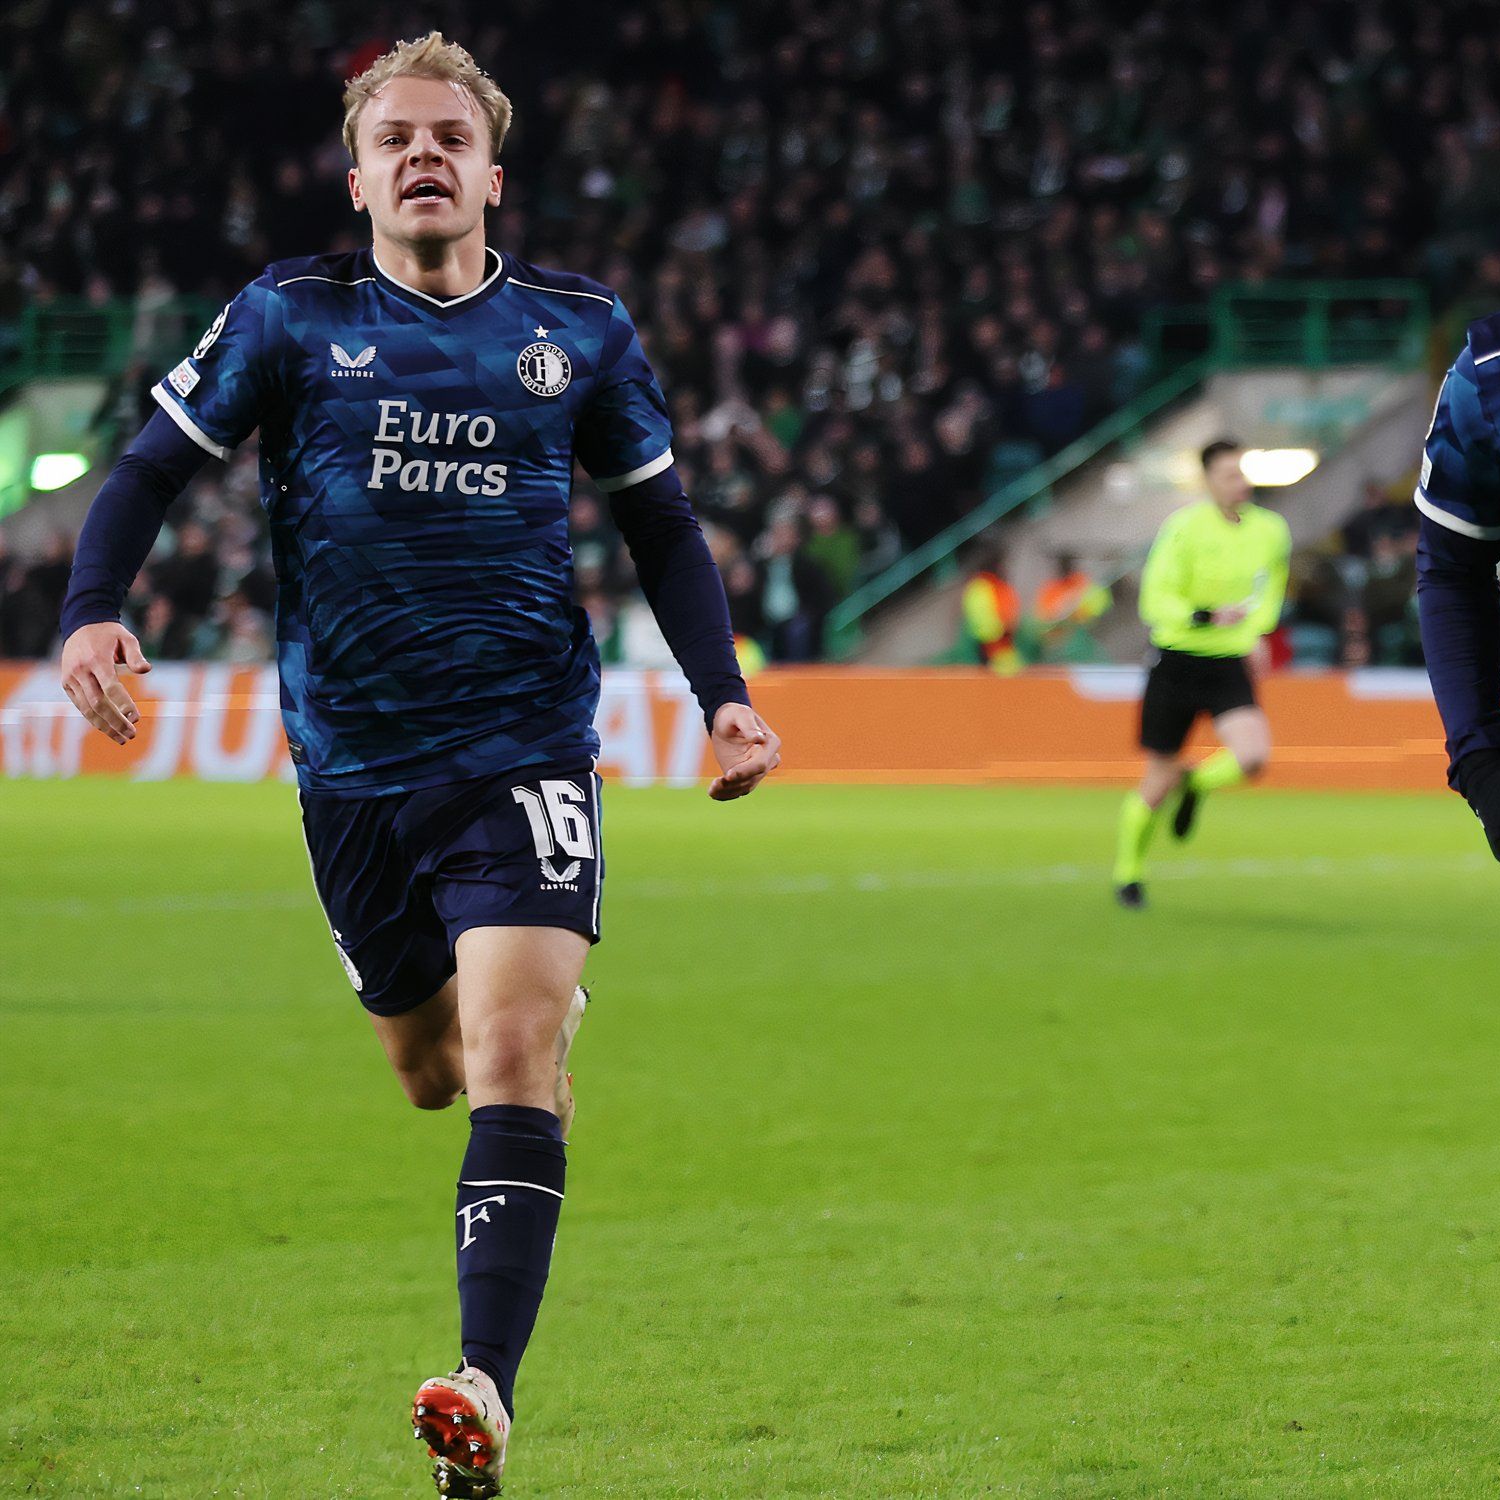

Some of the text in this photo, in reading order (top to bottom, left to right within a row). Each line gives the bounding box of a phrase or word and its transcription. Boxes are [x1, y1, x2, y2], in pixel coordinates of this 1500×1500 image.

[373, 400, 498, 448] Euro
[367, 449, 508, 496] Parcs
[131, 660, 706, 789] JU AT
[510, 780, 595, 859] 16
[456, 1194, 506, 1251] F
